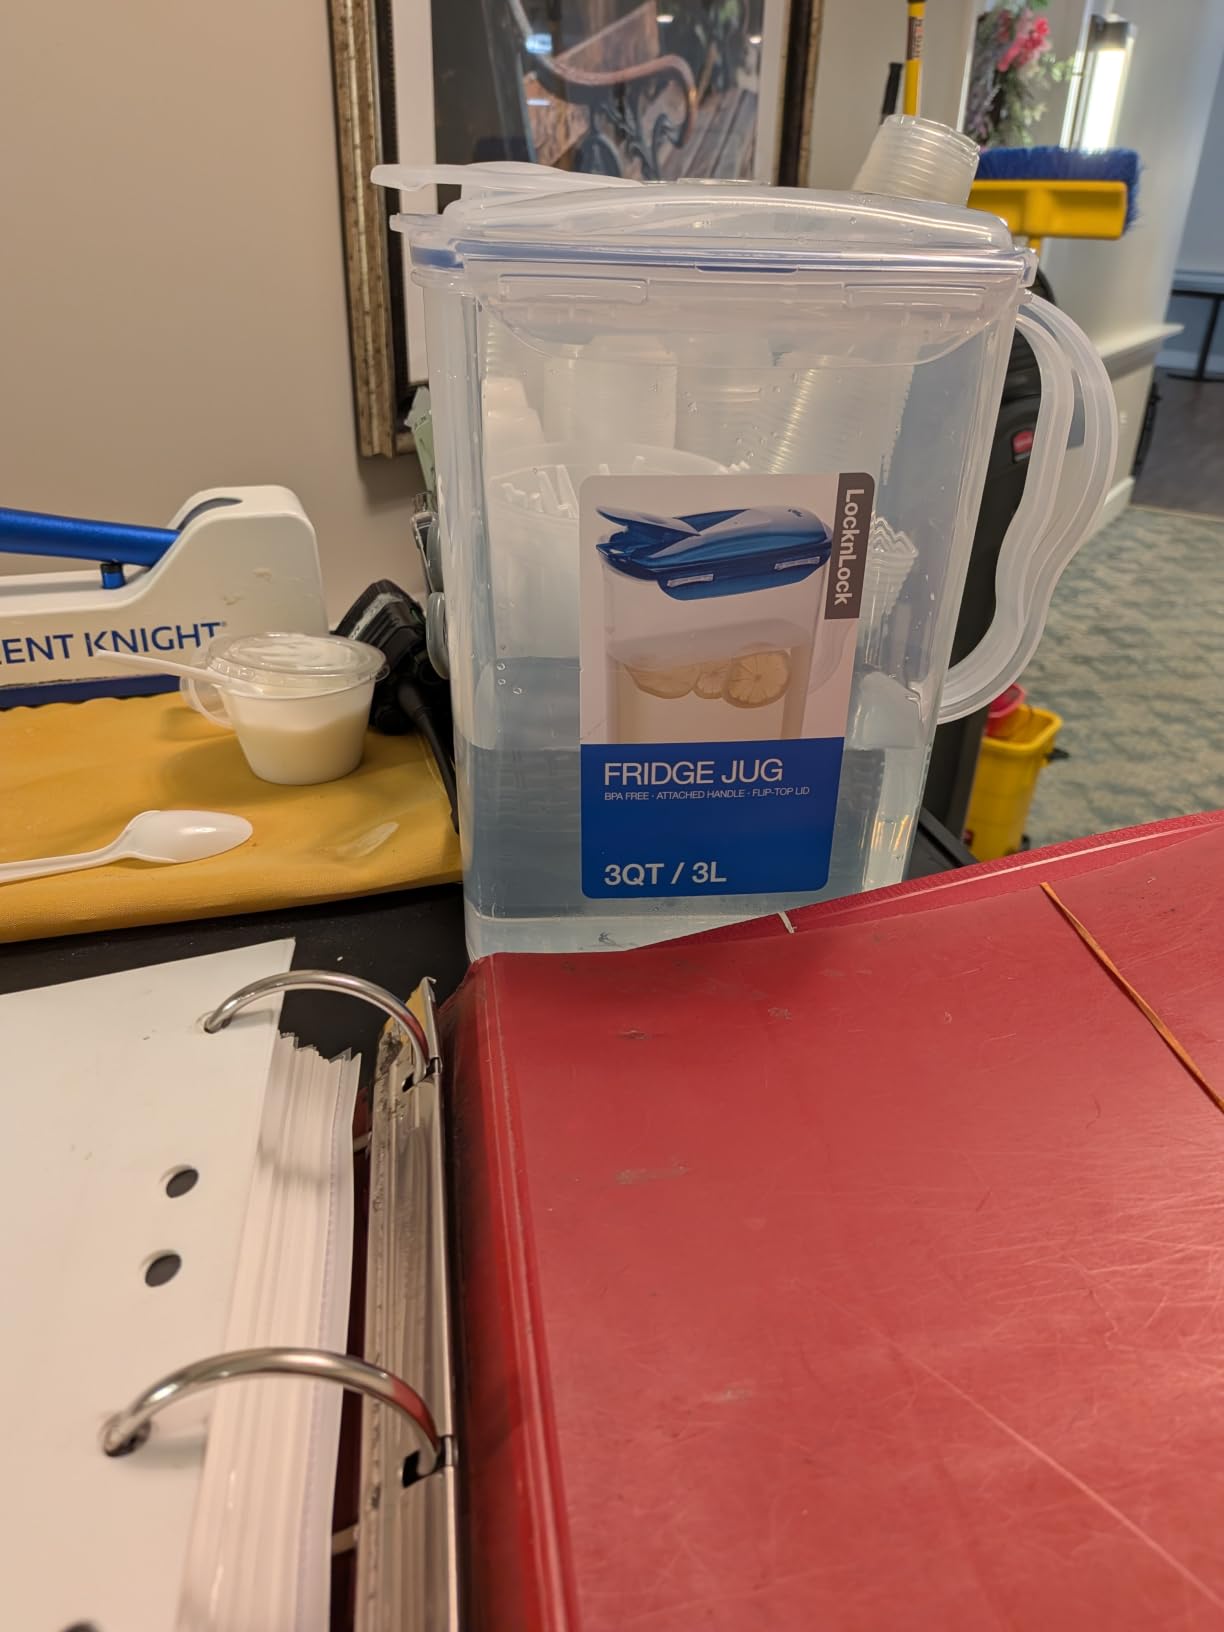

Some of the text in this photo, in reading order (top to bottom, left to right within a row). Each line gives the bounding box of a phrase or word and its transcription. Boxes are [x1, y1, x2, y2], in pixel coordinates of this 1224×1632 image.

[833, 488, 865, 606] LocknLock
[0, 634, 74, 664] ENT
[604, 758, 783, 786] FRIDGE JUG
[604, 791, 624, 801] BPA
[625, 791, 650, 801] FREE
[656, 790, 705, 800] ATTACHED
[706, 788, 745, 799] HANDLE
[752, 787, 794, 797] FLIP-TOP
[795, 786, 810, 796] LID
[604, 861, 727, 886] 3QT / 3L
